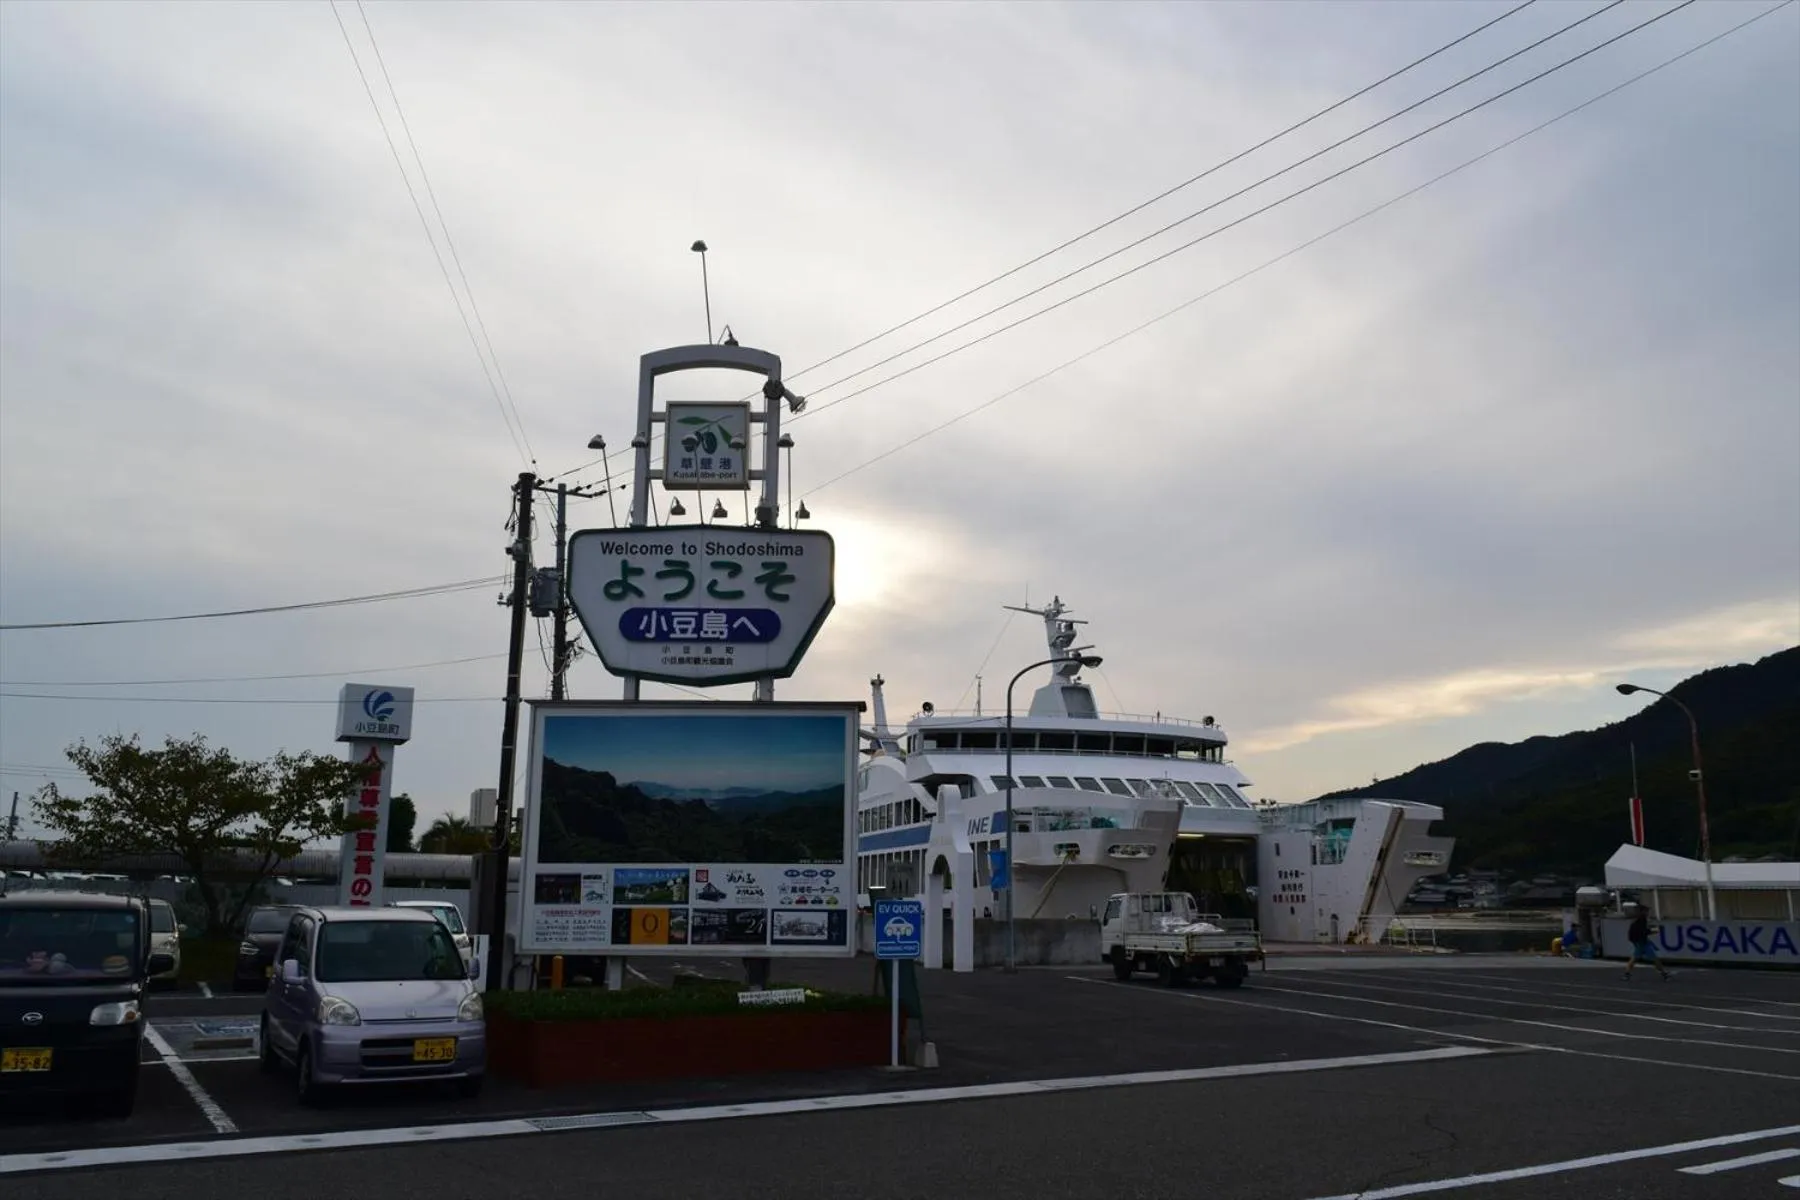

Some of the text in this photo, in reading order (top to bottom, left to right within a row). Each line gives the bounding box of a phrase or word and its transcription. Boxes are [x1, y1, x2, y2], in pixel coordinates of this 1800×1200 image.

[601, 541, 804, 557] Welcome to Shodoshima
[603, 559, 796, 602] ようこそ
[638, 610, 761, 640] 小豆島へ
[355, 721, 400, 736] 小豆島町
[878, 904, 920, 914] EV QUICK
[1652, 925, 1799, 955] USAKA
